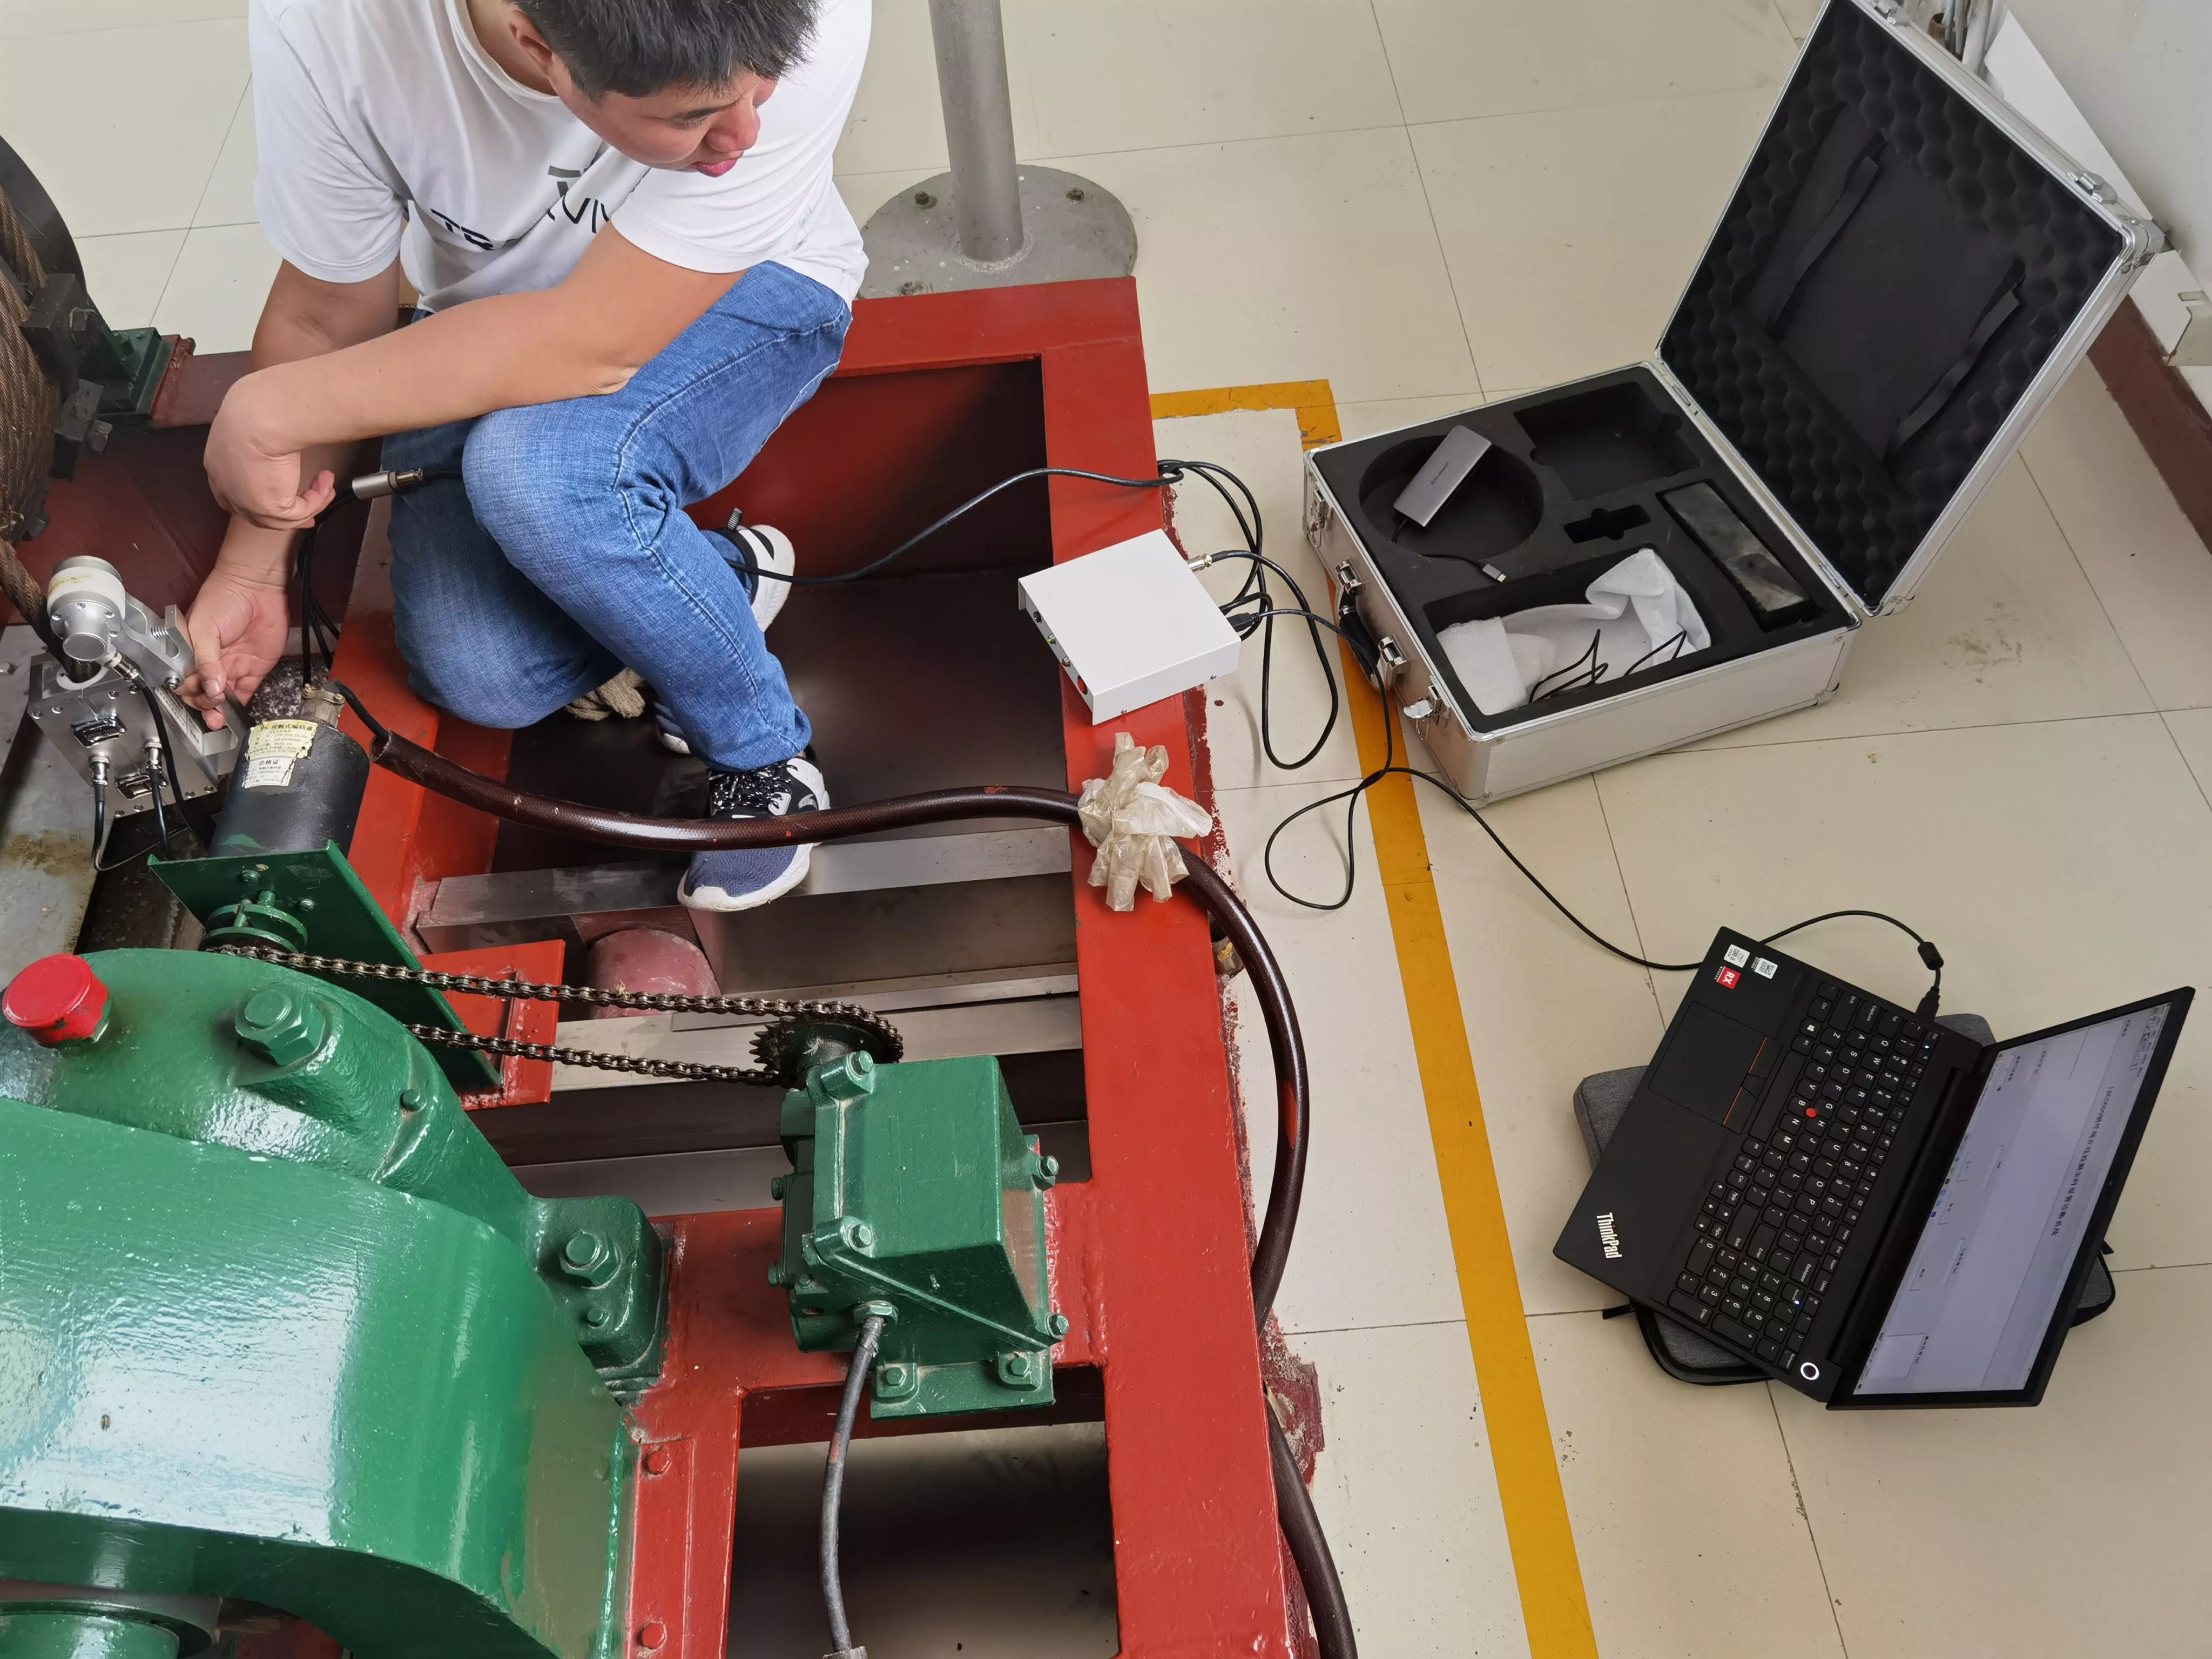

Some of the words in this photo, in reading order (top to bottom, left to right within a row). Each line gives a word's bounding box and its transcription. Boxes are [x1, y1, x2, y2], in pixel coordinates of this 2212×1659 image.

[1722, 971, 1735, 985] RX
[1866, 1005, 1877, 1021] CapsLock
[1596, 1212, 1622, 1259] ThinkPad
[1800, 1263, 1812, 1282] Backspace
[1700, 1309, 1708, 1319] Enter
